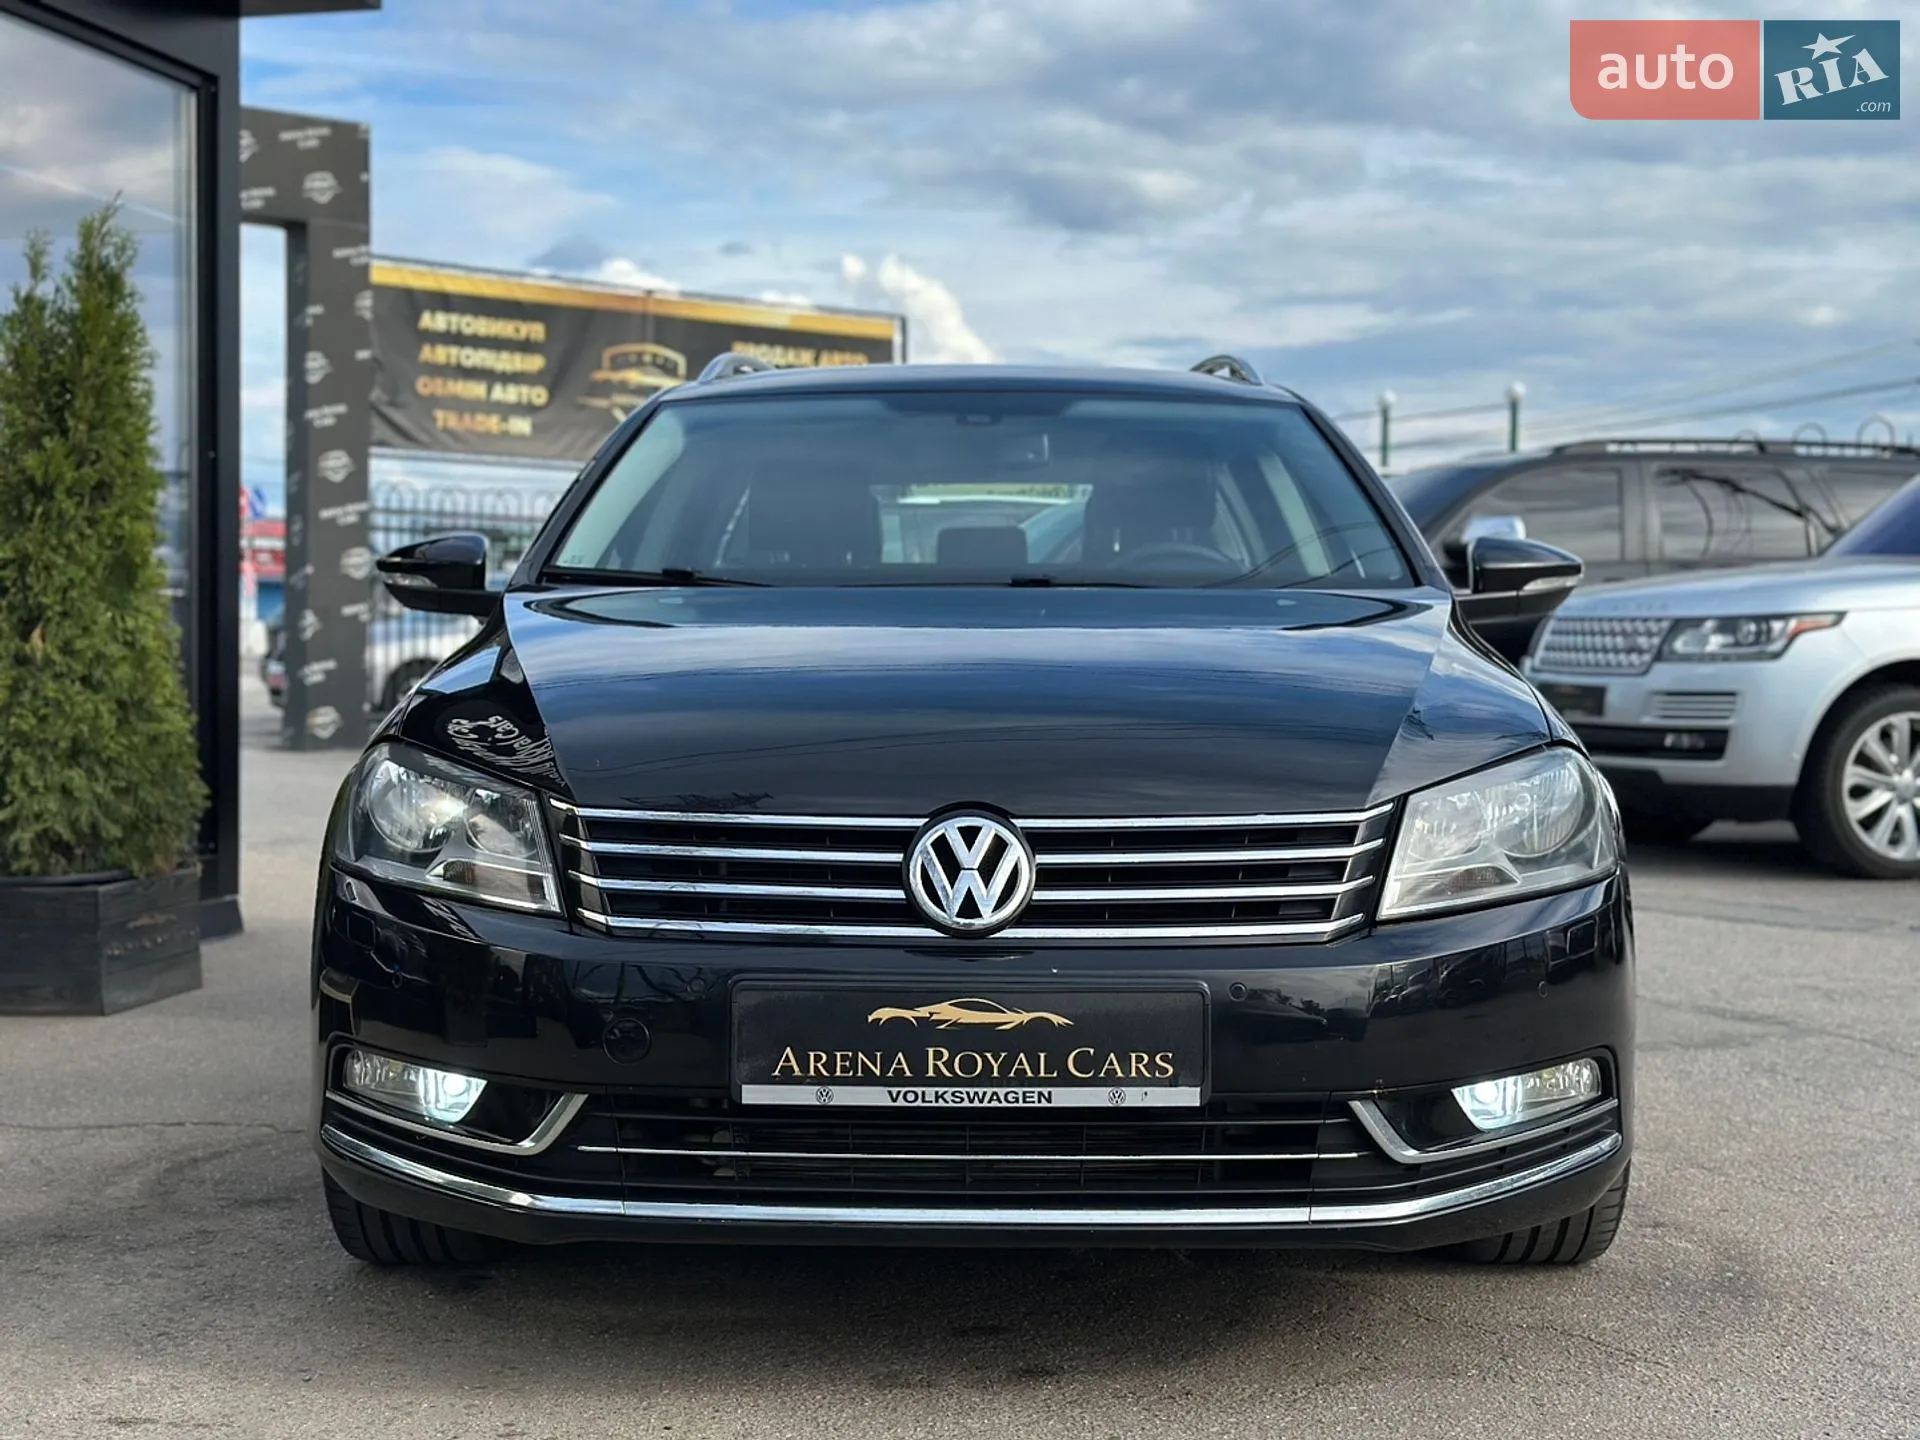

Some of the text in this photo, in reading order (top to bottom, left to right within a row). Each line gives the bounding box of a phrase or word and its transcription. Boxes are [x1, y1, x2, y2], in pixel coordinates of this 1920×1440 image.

[490, 381, 550, 406] АВТО
[433, 408, 532, 437] TRADE-IN
[771, 1046, 1174, 1079] ARENA ROYAL CARS
[887, 1090, 1053, 1104] VOLKSWAGEN
